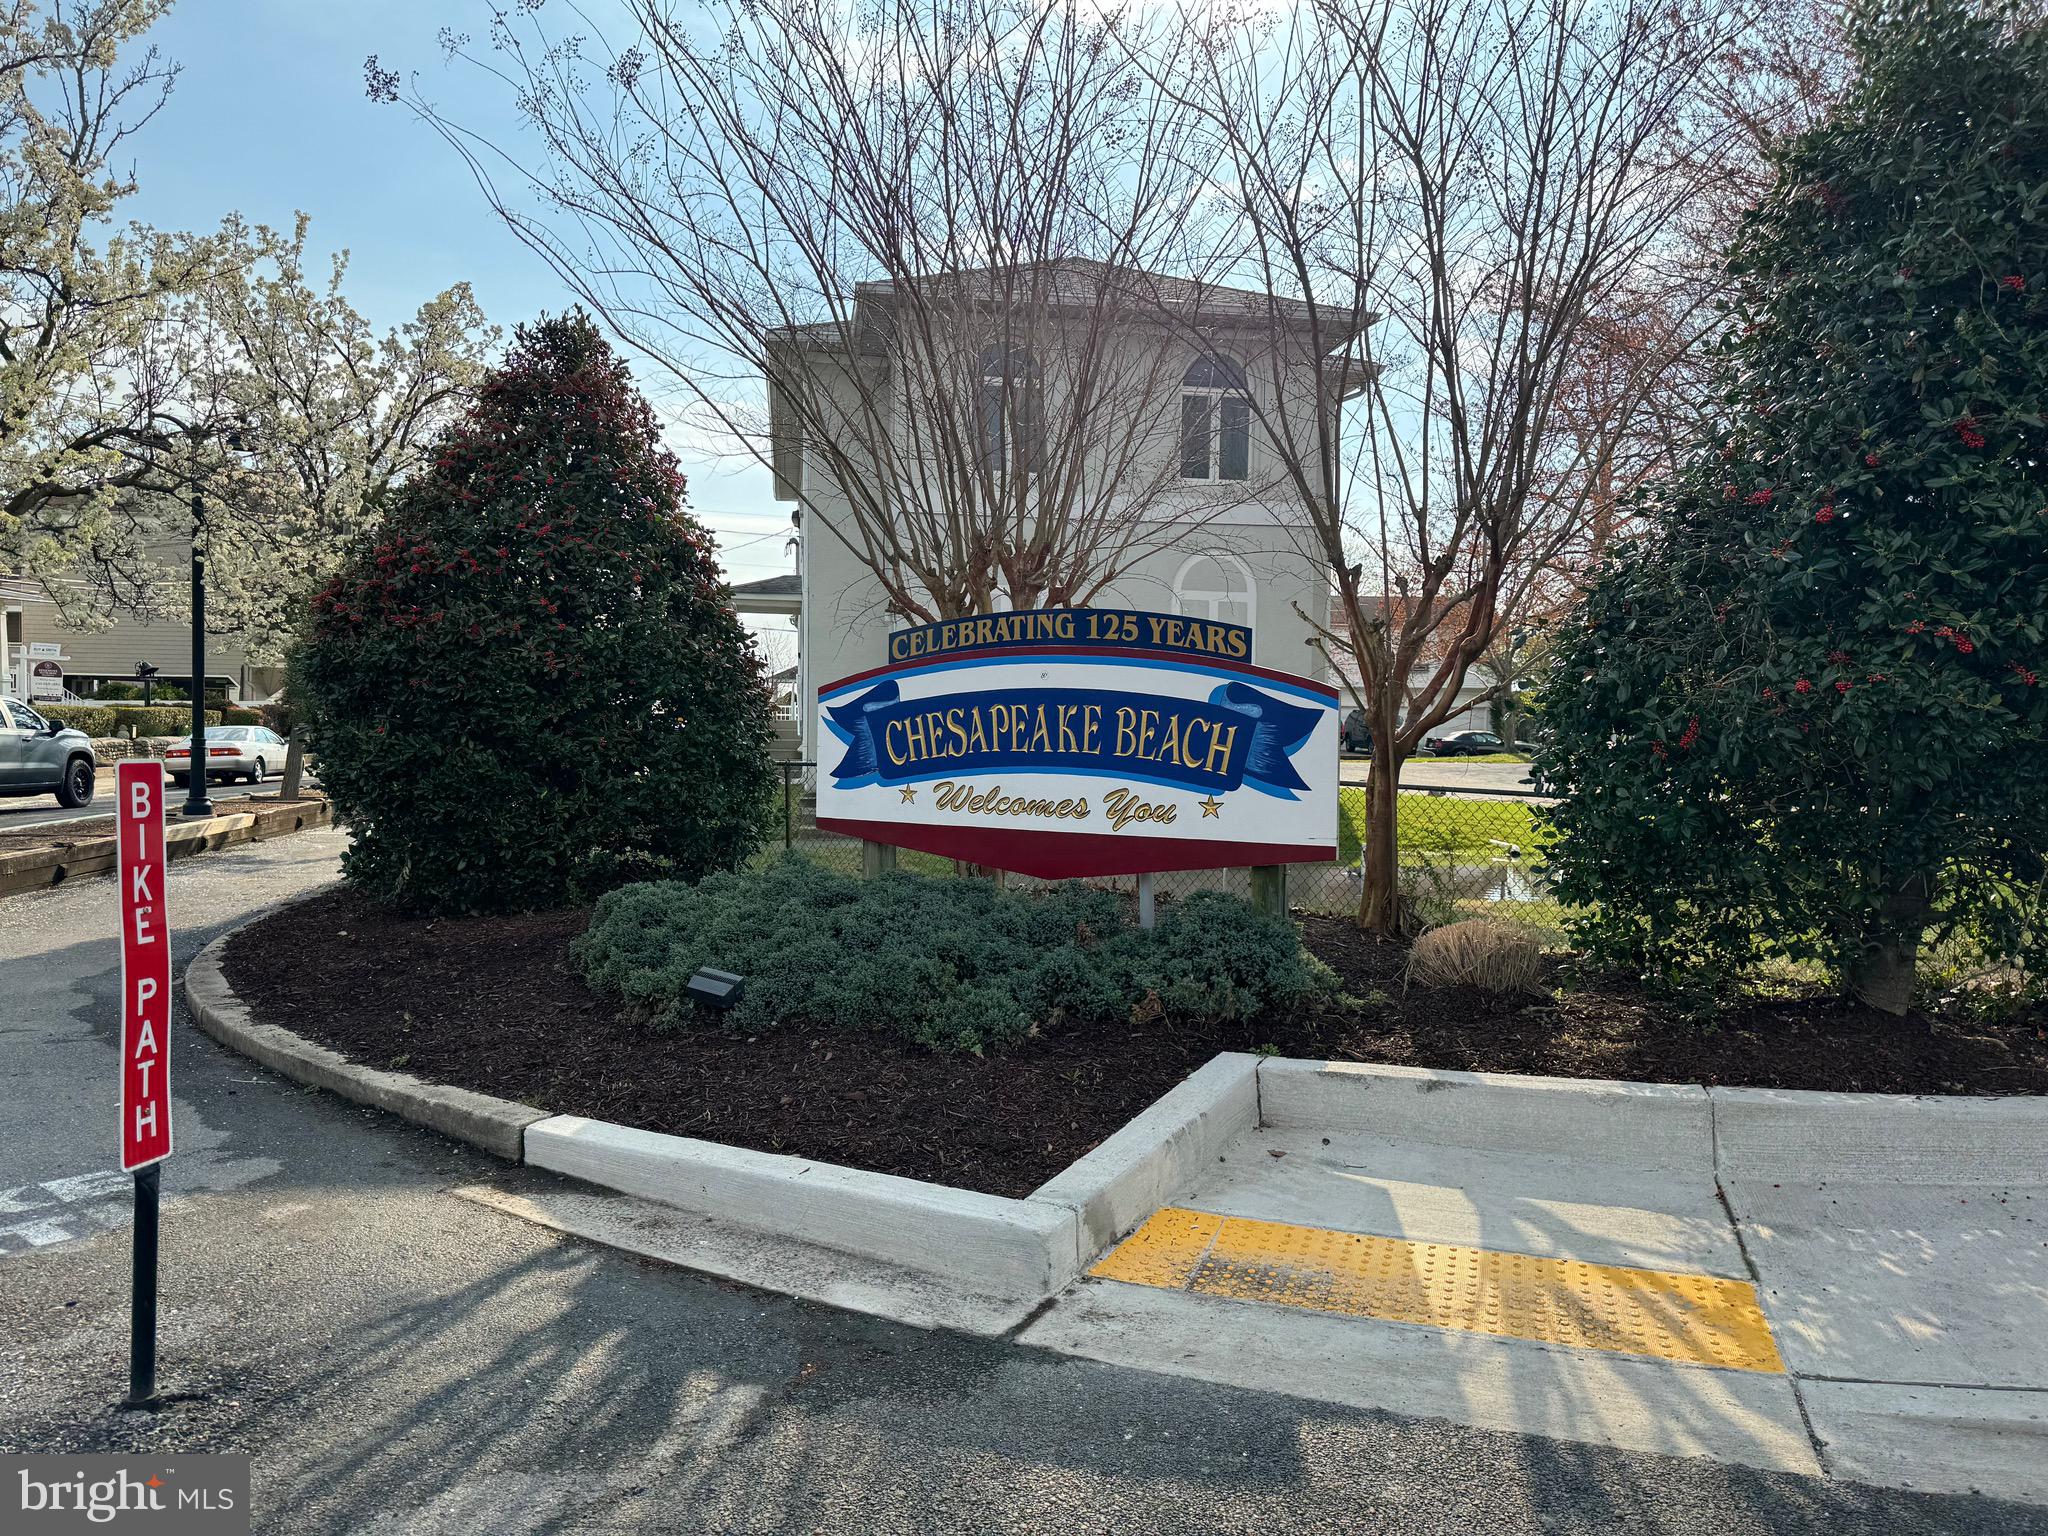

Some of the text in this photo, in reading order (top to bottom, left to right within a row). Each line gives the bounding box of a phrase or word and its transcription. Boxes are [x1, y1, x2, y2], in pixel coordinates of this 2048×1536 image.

[892, 613, 1248, 660] CELEBRATING 125 YEARS
[885, 703, 1239, 776] CHESAPEAKE BEACH
[932, 781, 1178, 832] Welcomes You
[130, 781, 158, 1143] BIKE PATH
